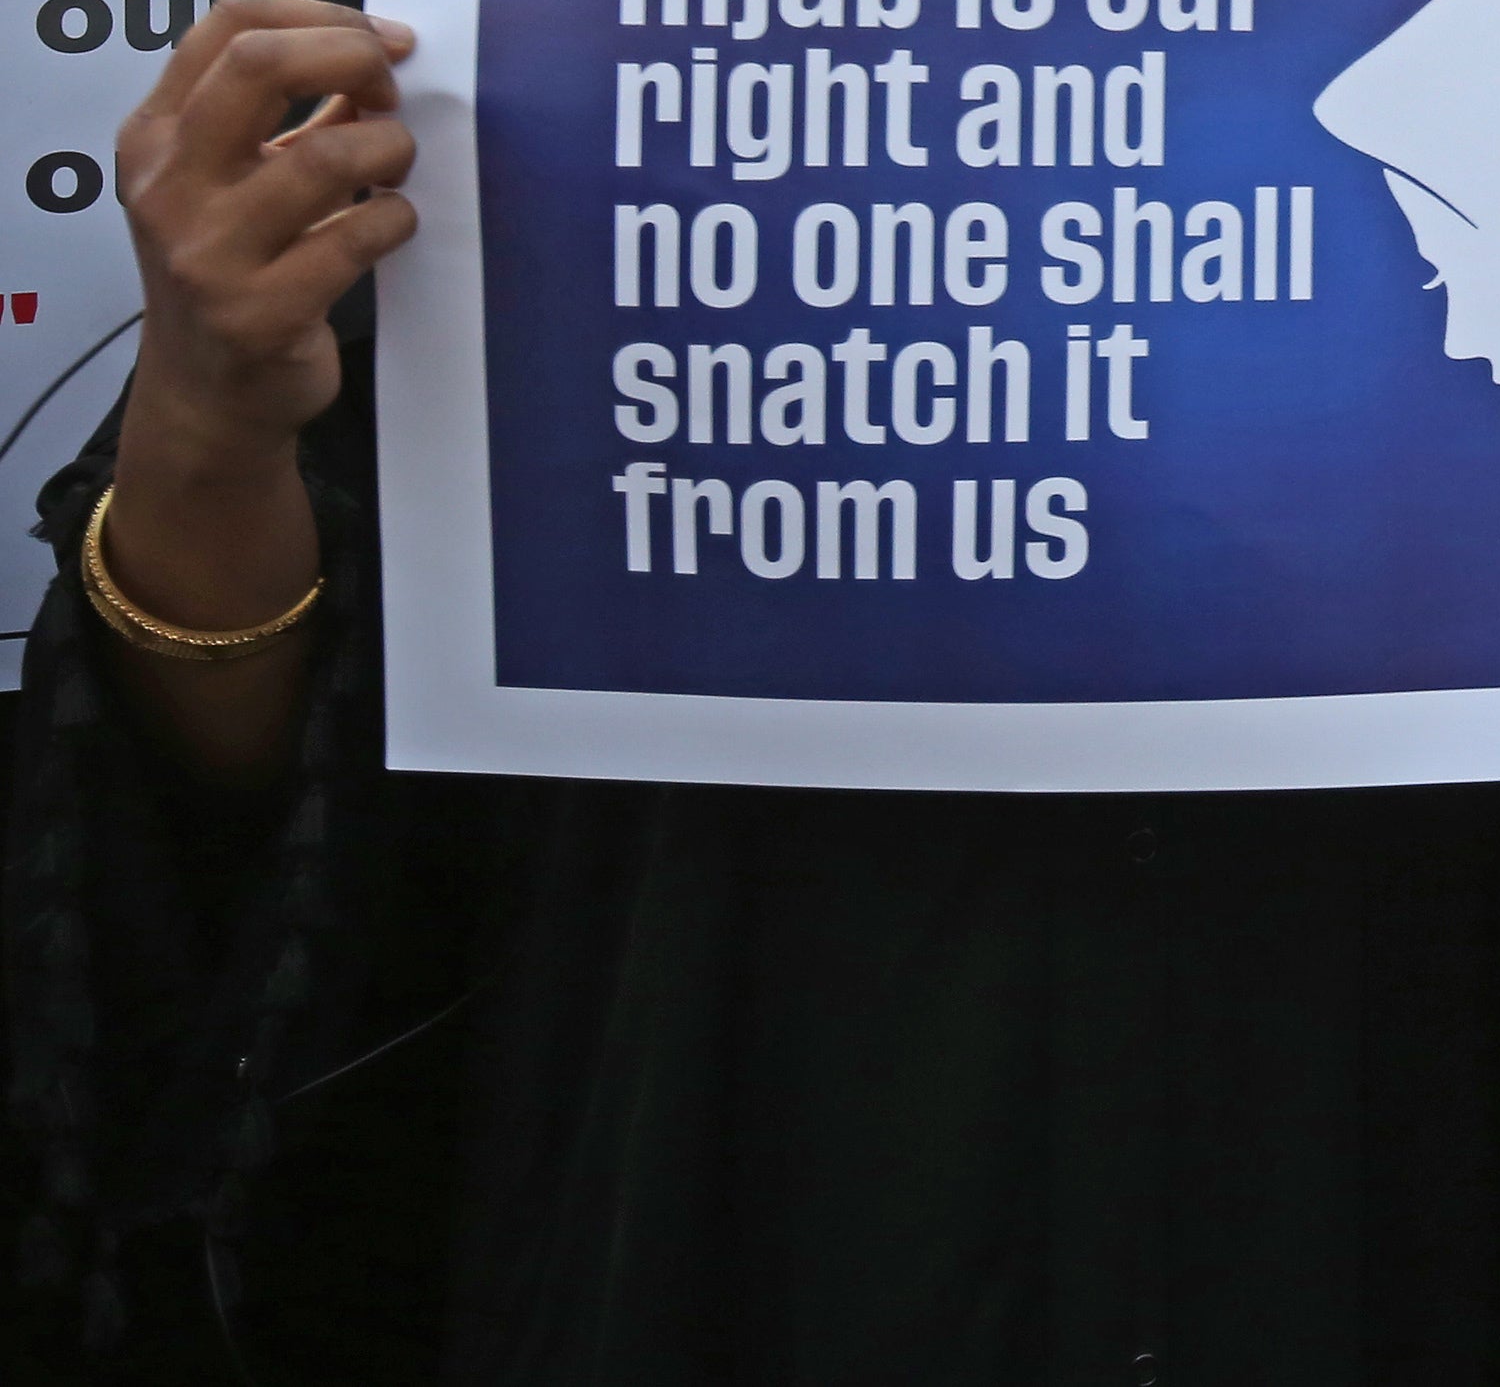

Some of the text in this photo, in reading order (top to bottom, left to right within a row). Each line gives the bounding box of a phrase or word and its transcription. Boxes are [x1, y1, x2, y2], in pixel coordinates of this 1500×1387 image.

[615, 47, 1166, 180] right and
[615, 186, 1315, 308] no one shall
[613, 324, 1149, 445] snatch it
[613, 463, 1088, 580] from us
